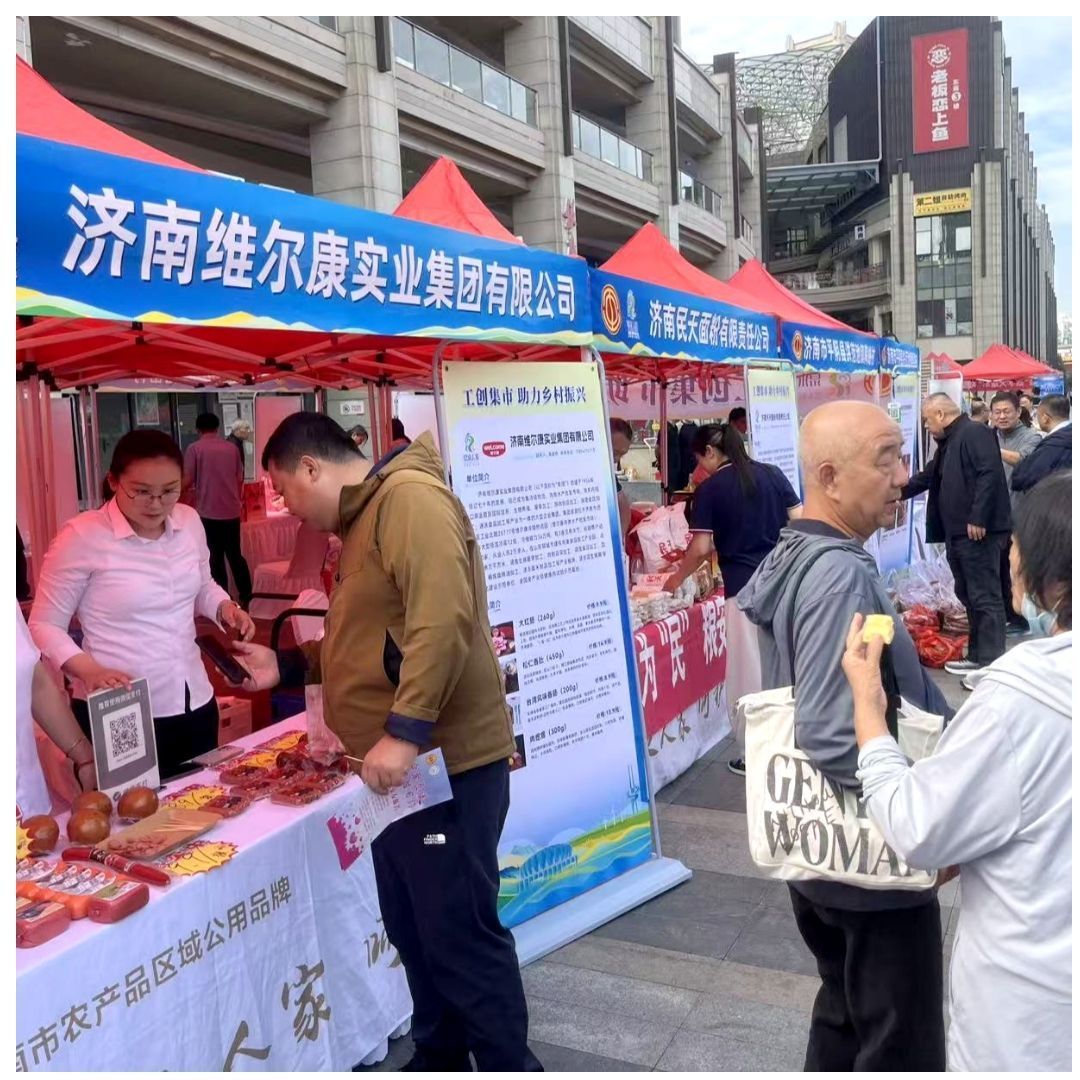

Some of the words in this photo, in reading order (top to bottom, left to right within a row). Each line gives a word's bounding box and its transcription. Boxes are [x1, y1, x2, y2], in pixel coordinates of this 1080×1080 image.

[931, 69, 949, 142] 老板恋上鱼
[62, 184, 576, 321] 济南维尔康实业集团有限公司
[649, 299, 770, 353] 济南民天面粉有限责任公司
[464, 387, 513, 407] 工创集市
[518, 386, 587, 405] 助力乡村振兴
[510, 430, 595, 448] 济南维尔康实业集团有限公司
[764, 810, 932, 878] WOMA
